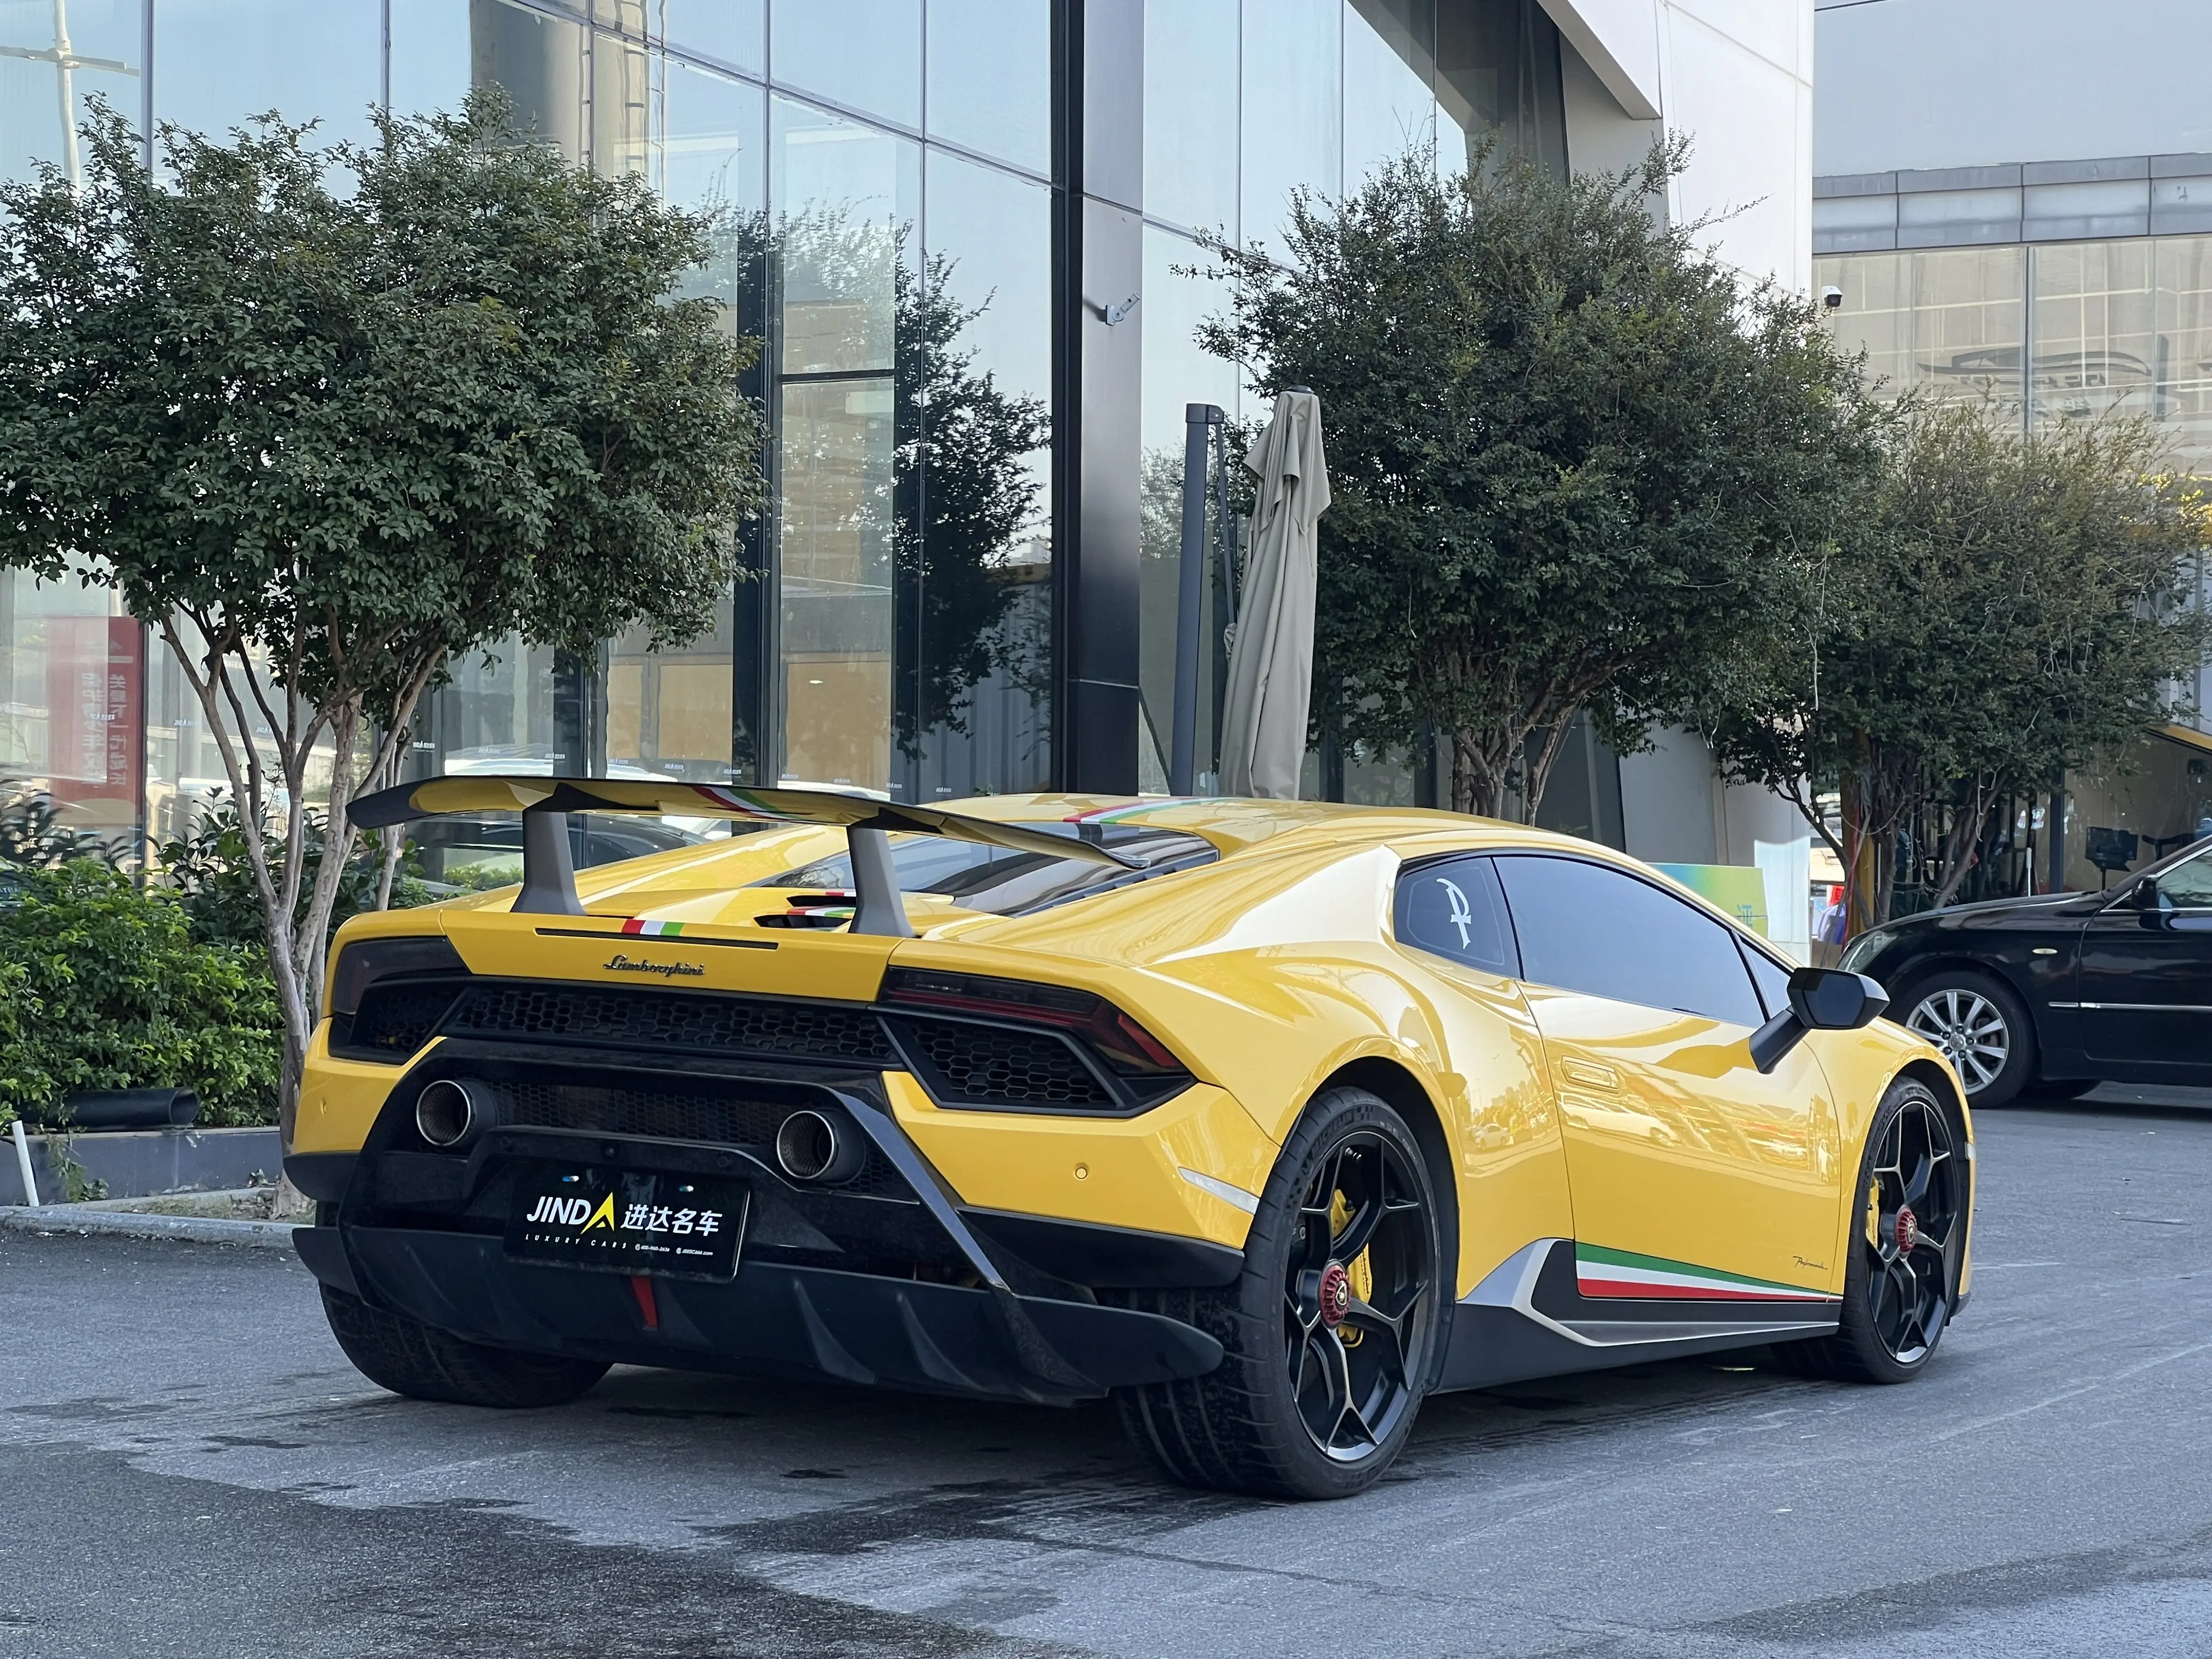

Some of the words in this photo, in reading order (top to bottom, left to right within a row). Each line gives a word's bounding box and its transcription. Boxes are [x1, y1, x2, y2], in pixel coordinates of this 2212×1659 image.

[603, 955, 705, 977] Lamborghini
[1311, 1109, 1354, 1157] MICHELIN
[527, 1192, 614, 1234] JINDA
[620, 1204, 723, 1236] 进达名车
[525, 1234, 580, 1244] LUXURY
[591, 1239, 627, 1249] CARS
